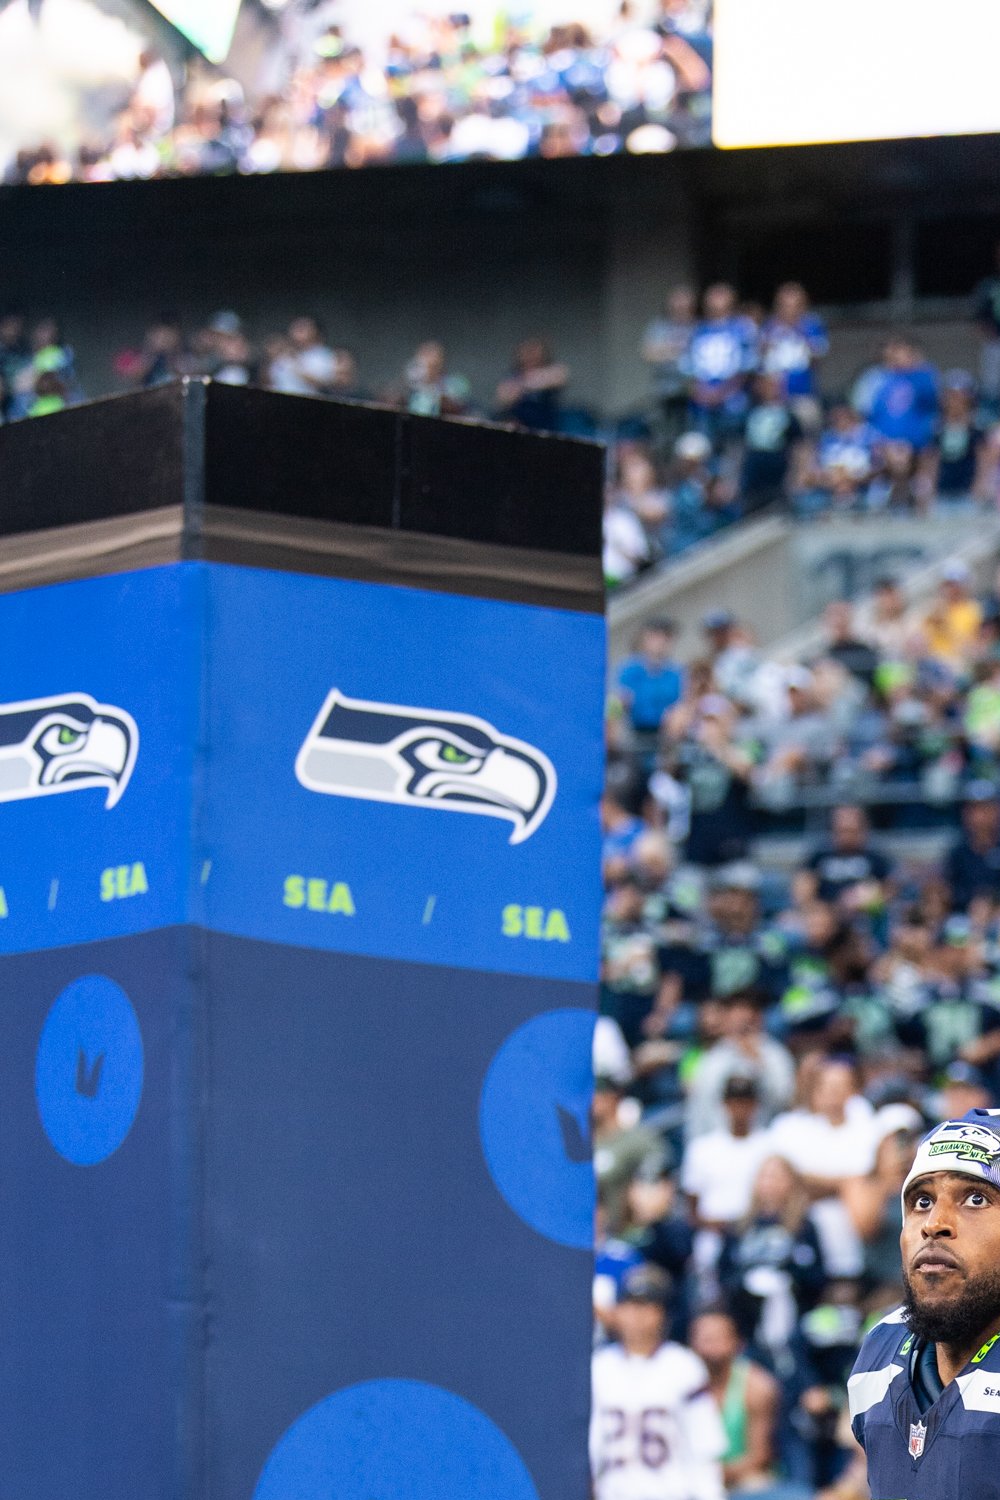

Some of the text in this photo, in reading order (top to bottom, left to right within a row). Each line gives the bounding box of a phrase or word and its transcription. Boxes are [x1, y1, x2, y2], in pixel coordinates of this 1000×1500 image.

[102, 862, 148, 901] SEA
[284, 875, 570, 942] SEA SEA
[931, 1143, 971, 1154] SEAHAWKS
[969, 1151, 986, 1160] NFC
